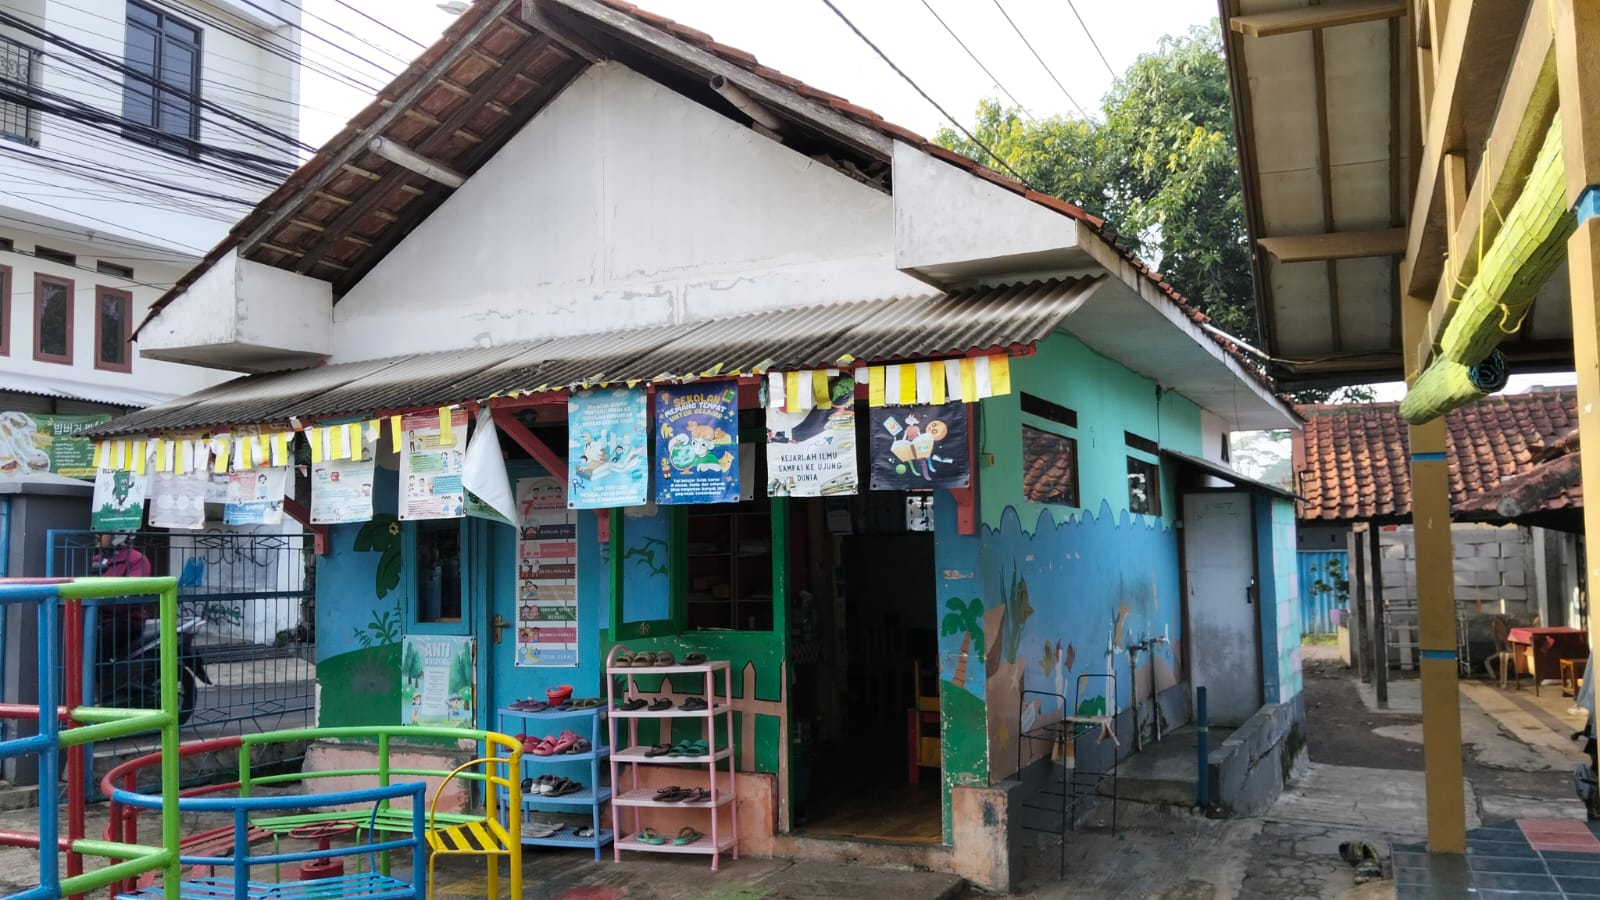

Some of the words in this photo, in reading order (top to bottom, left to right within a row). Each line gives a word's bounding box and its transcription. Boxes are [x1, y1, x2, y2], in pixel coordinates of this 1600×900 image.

[673, 393, 721, 407] SEKOLAH
[664, 403, 697, 418] MEMANG
[699, 402, 727, 413] TEMPAT
[668, 410, 692, 422] UNTUK
[694, 409, 723, 420] BELAJAR
[780, 453, 817, 462] KEJARLAH
[819, 452, 838, 460] ILMU
[778, 464, 804, 472] SAMPAI
[805, 463, 815, 471] KE
[818, 462, 842, 470] UJUNG
[797, 474, 818, 482] DUNIA
[521, 499, 534, 516] 7
[424, 642, 450, 657] ANTI
